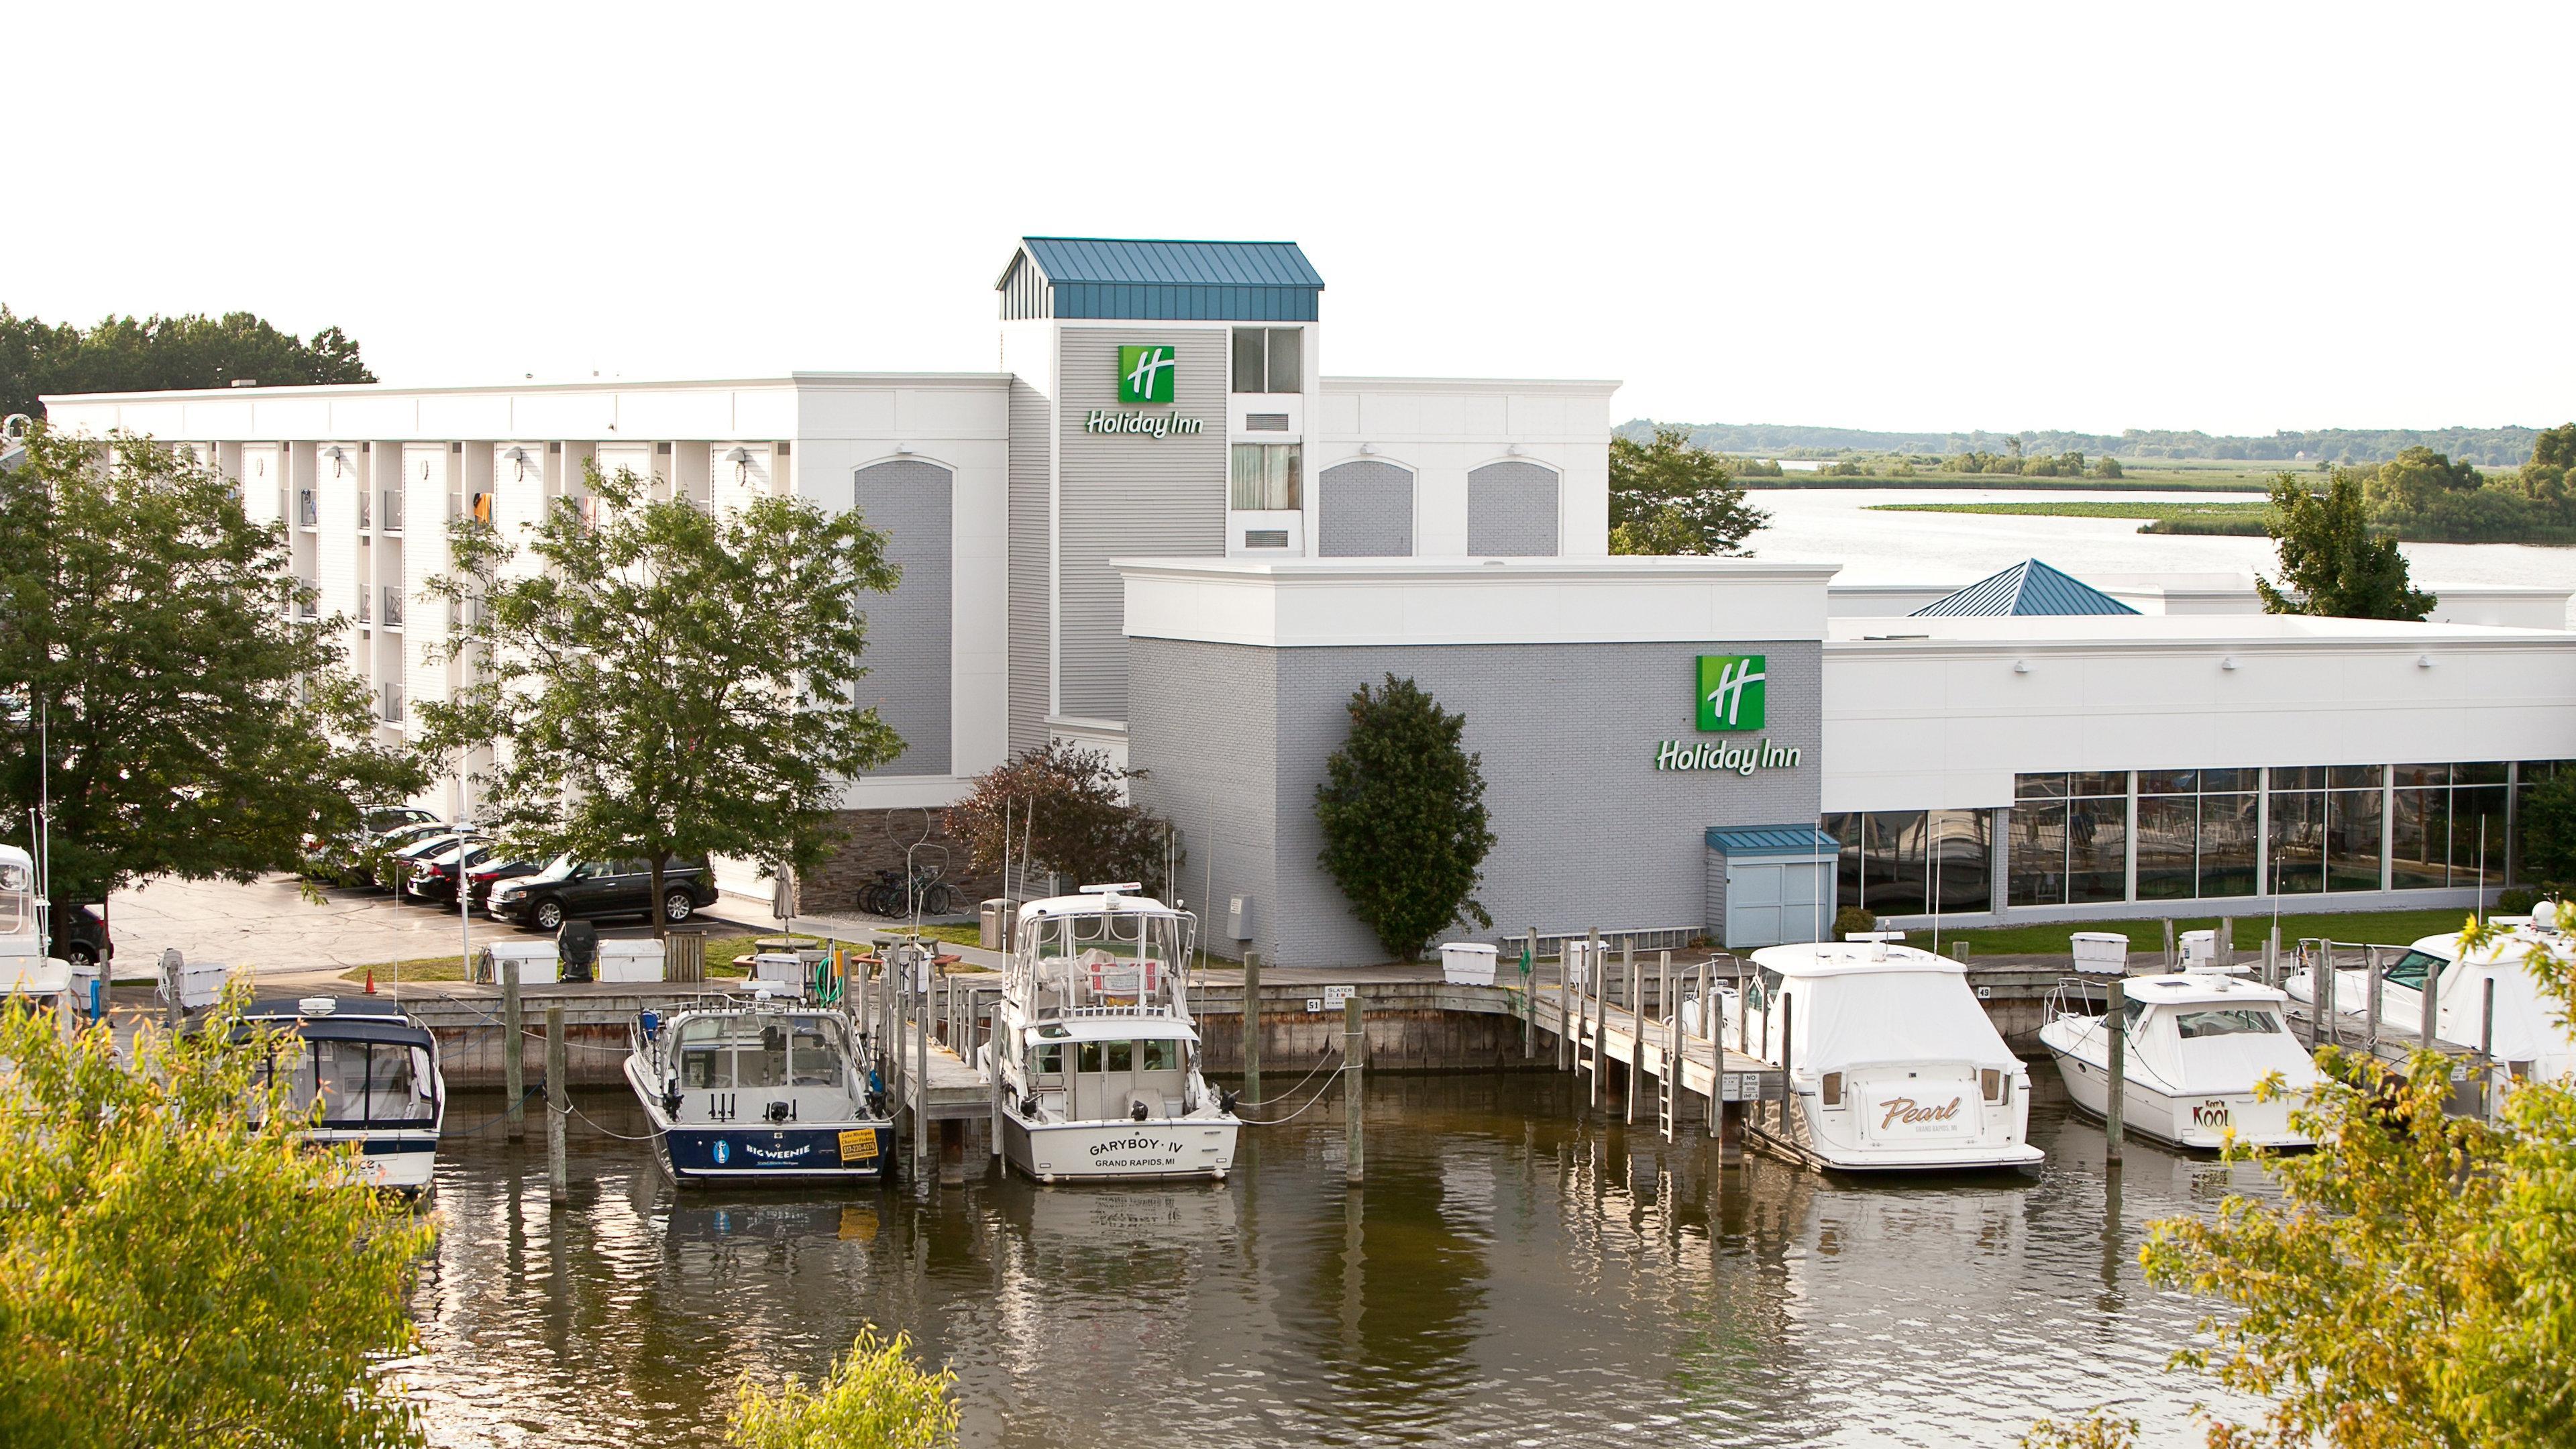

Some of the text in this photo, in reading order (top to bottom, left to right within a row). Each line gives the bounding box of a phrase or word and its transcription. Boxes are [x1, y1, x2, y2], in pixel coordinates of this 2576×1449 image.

[1128, 348, 1174, 399] H
[1087, 411, 1203, 439] Holiday Inn
[1707, 659, 1765, 725] H
[1657, 739, 1801, 775] Holiday Inn
[1880, 1096, 1960, 1130] Pearl
[747, 1144, 810, 1159] BIG WEENIE
[1089, 1138, 1159, 1156] GARYBOY
[1169, 1142, 1183, 1153] IV
[1095, 1159, 1127, 1167] GRAND
[1130, 1159, 1164, 1167] RAPIDS,
